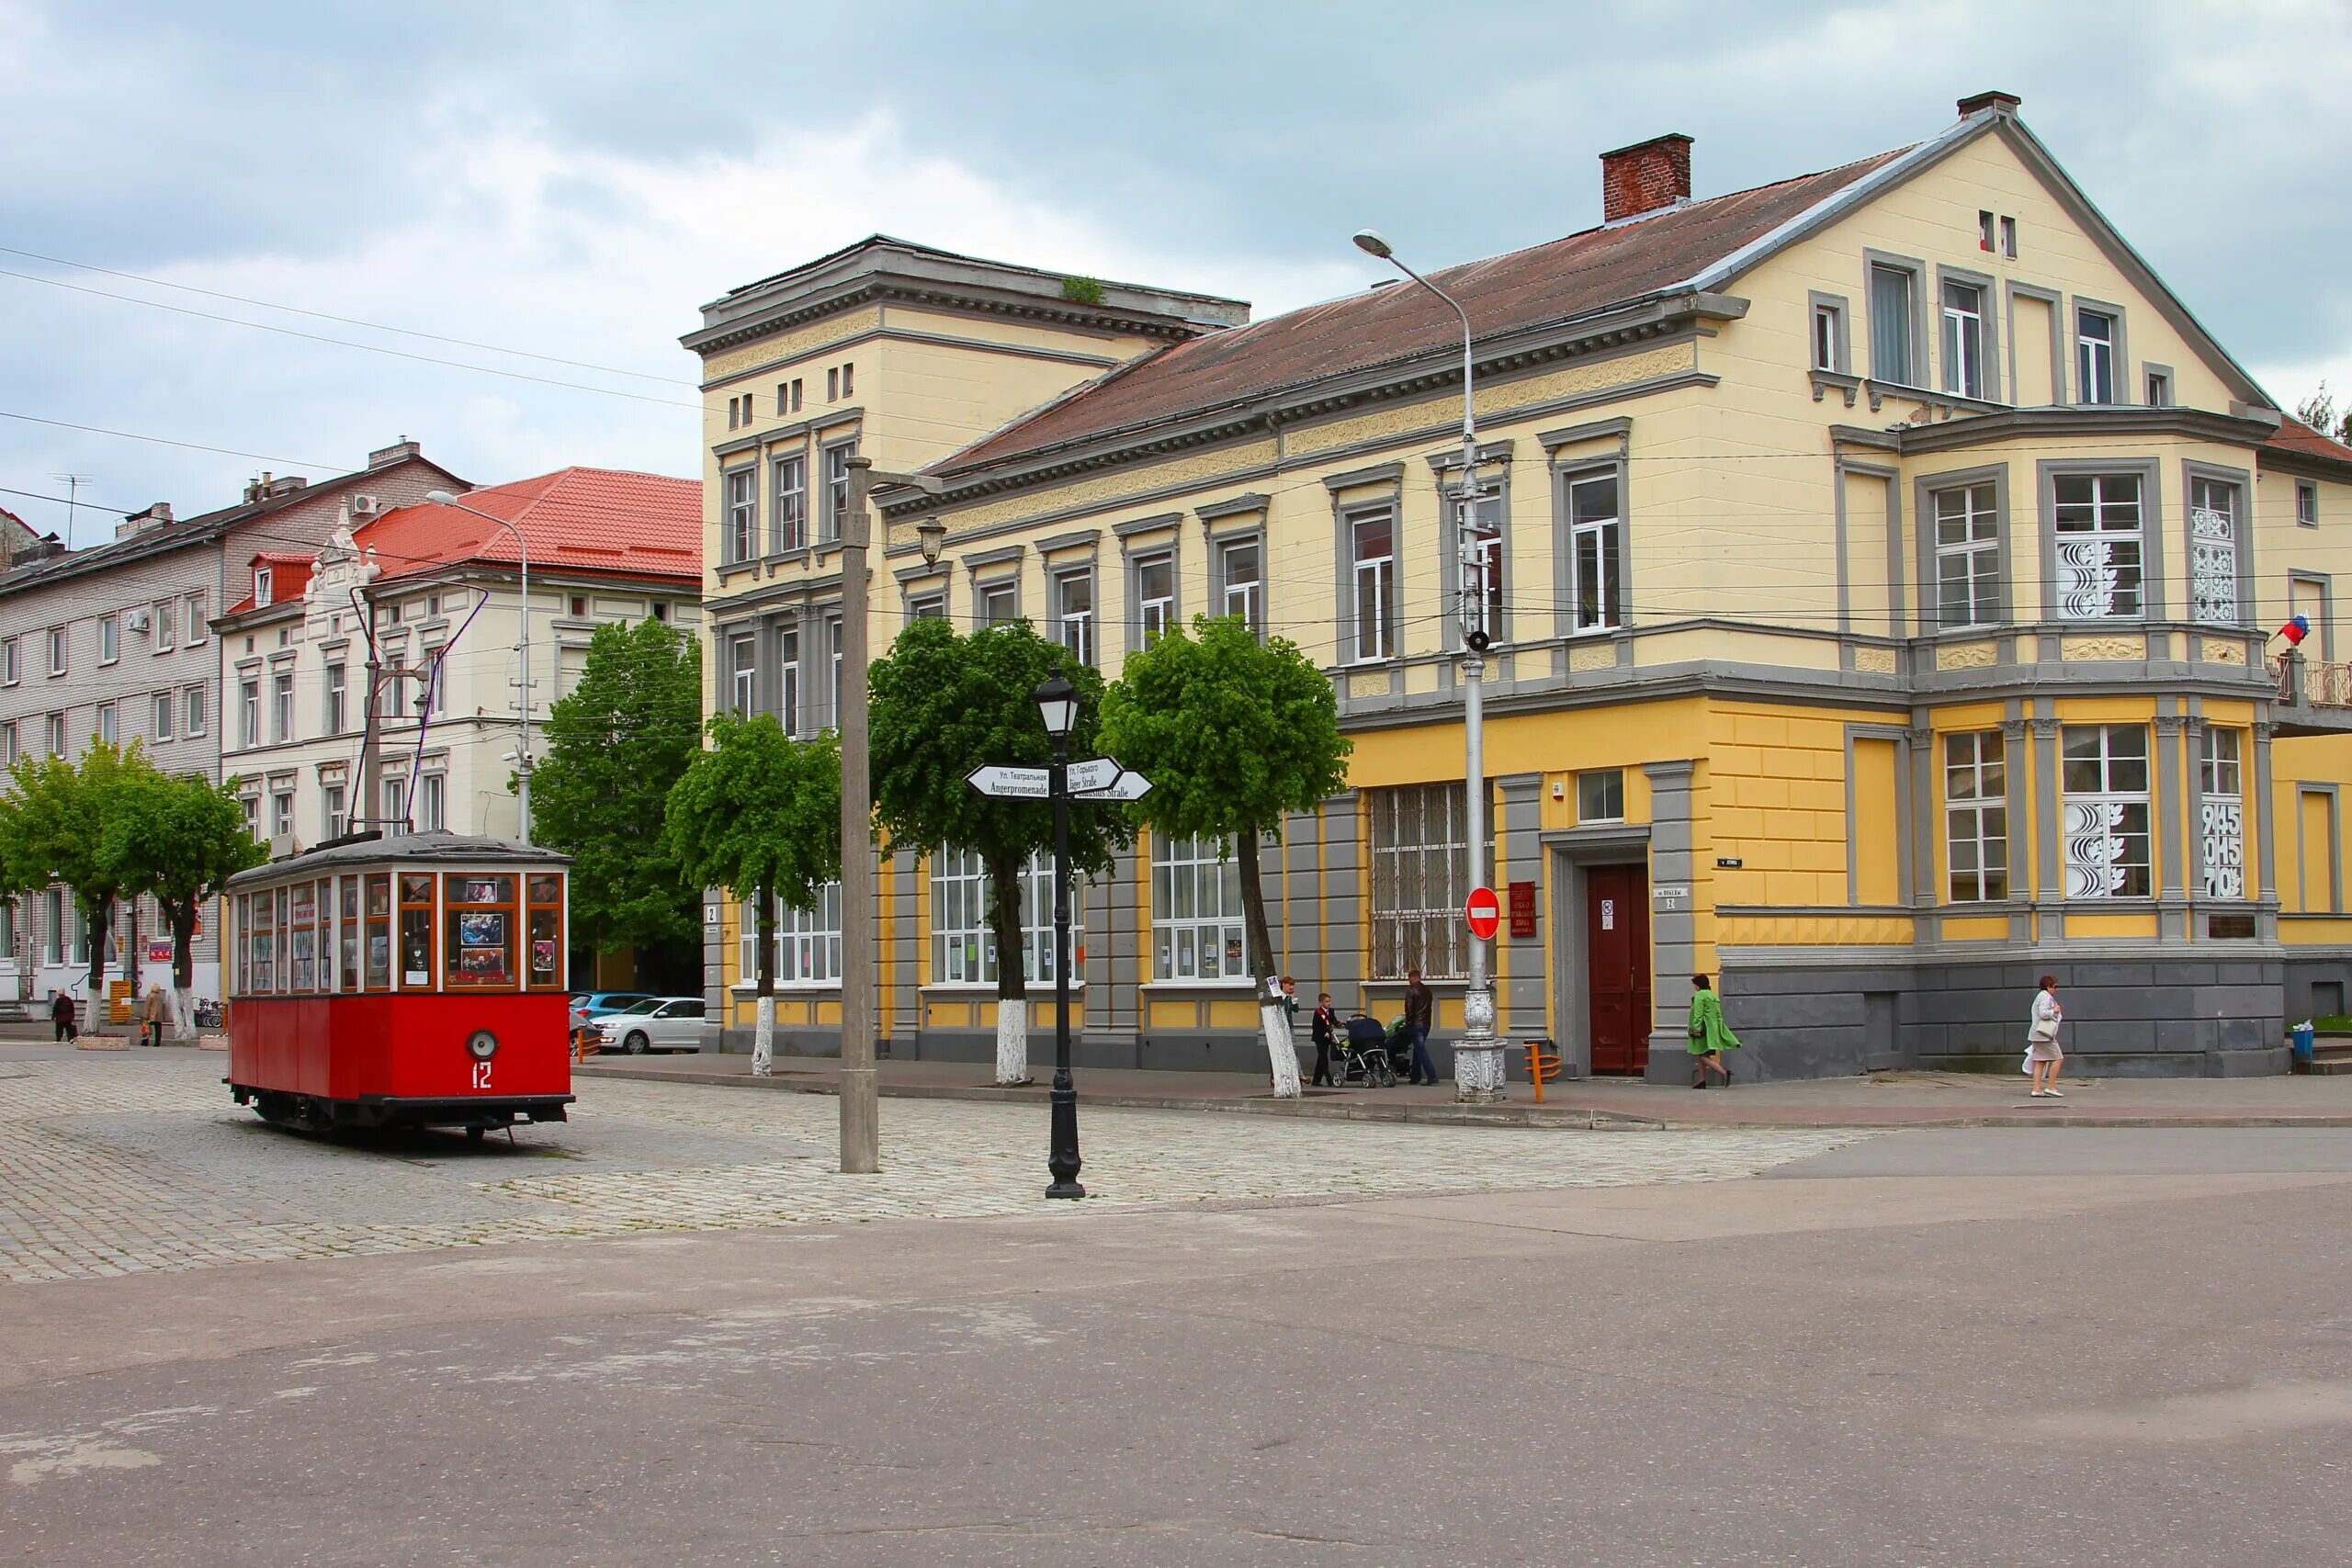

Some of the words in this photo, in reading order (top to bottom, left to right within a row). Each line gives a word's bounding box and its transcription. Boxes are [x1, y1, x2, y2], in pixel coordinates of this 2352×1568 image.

[1077, 764, 1099, 775] Горького
[1010, 771, 1047, 782] Театральная
[990, 781, 1047, 795] Angerpromenade
[1106, 786, 1129, 797] Straße
[2203, 836, 2242, 865] 015
[709, 908, 714, 920] 2
[472, 1061, 492, 1089] 12
